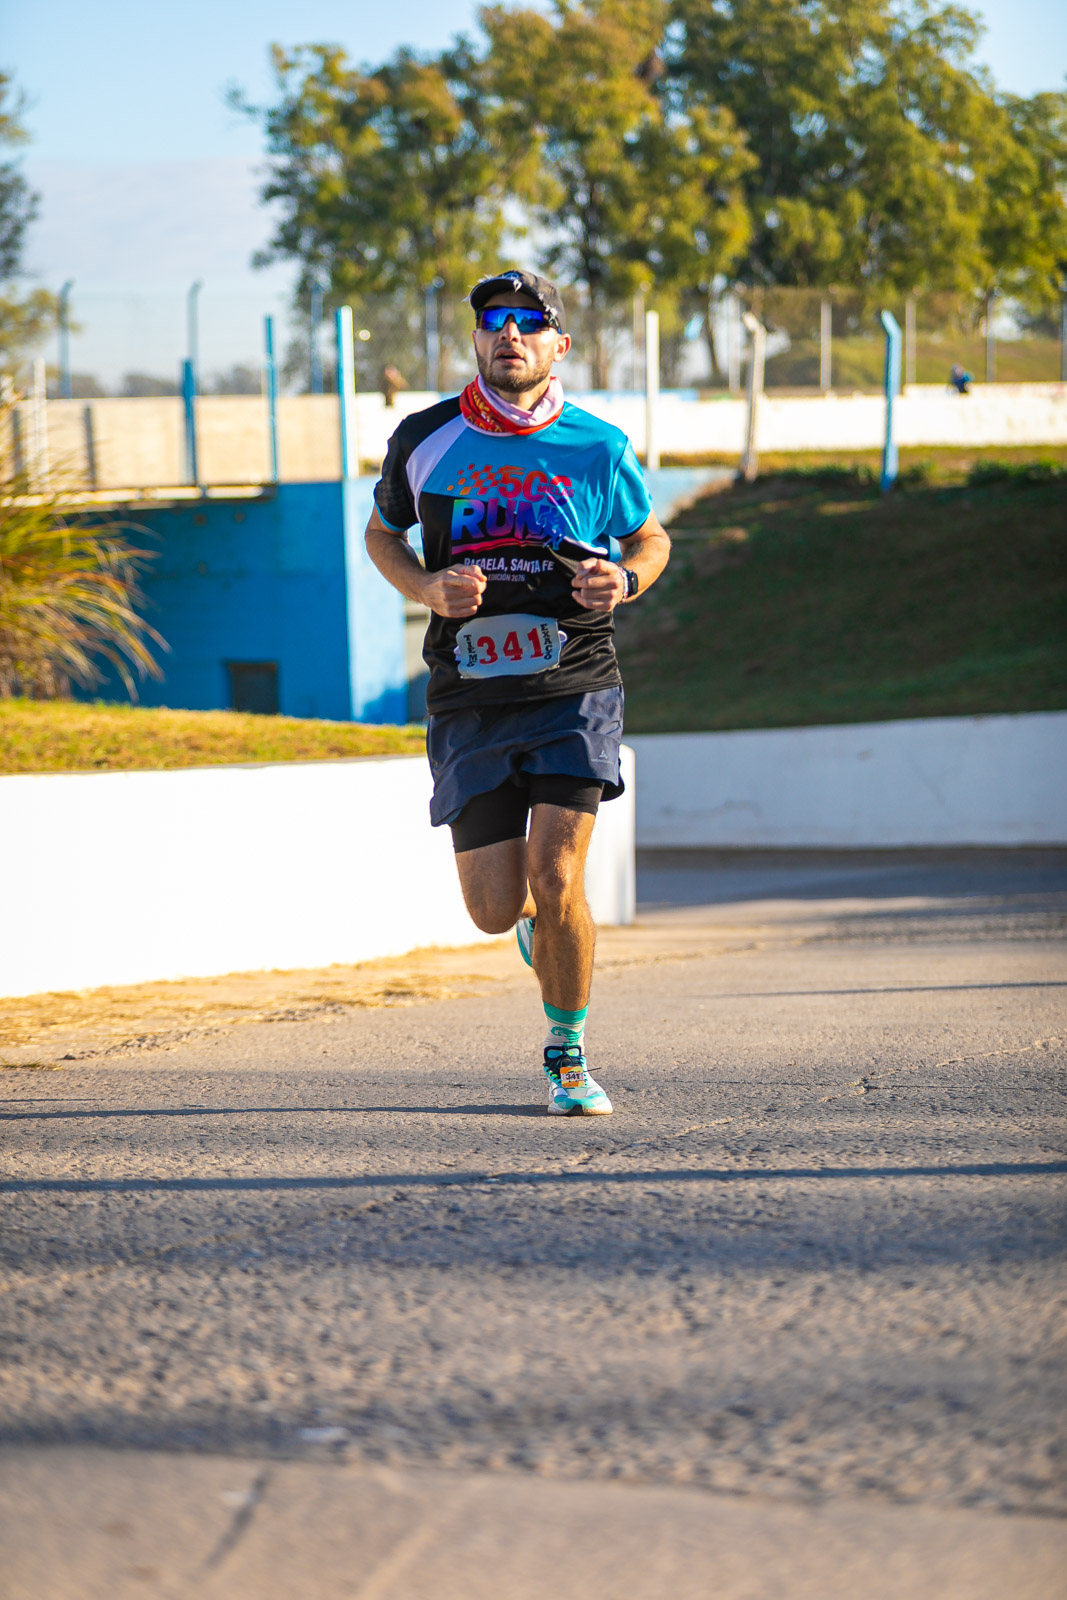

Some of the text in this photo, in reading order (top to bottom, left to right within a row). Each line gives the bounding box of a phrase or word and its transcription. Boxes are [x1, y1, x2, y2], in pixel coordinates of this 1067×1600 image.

[511, 558, 540, 573] SANTA
[542, 560, 555, 571] FE
[477, 627, 544, 665] 341
